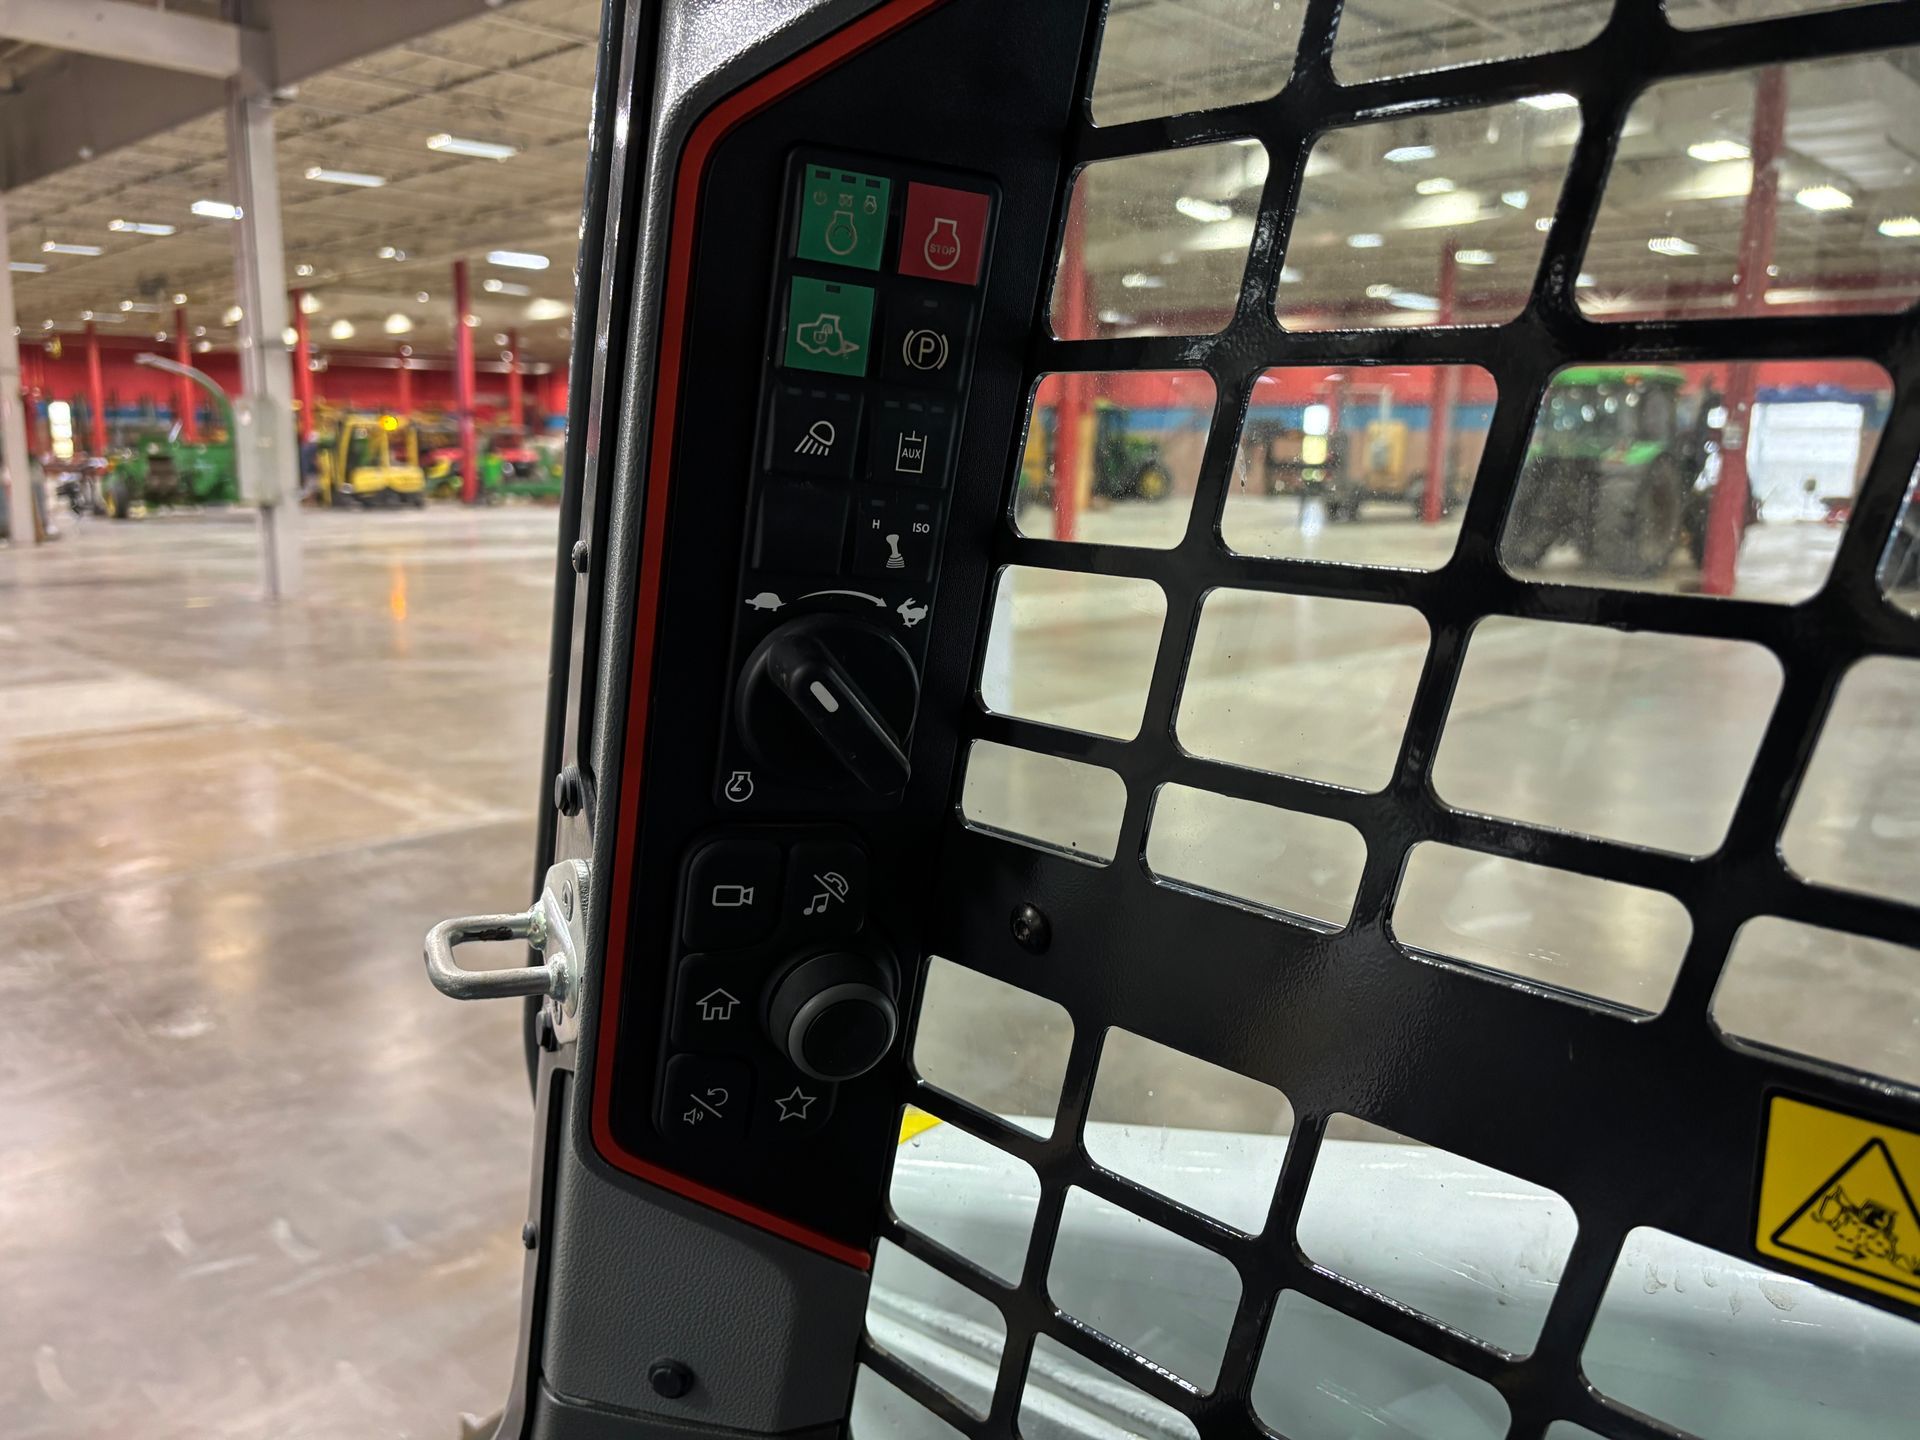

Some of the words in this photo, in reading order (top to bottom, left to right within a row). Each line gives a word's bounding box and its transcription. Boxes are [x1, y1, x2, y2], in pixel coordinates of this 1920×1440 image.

[929, 243, 956, 256] STOP
[918, 337, 935, 363] P
[901, 448, 921, 460] AUX
[872, 519, 881, 530] H
[912, 522, 930, 534] ISO
